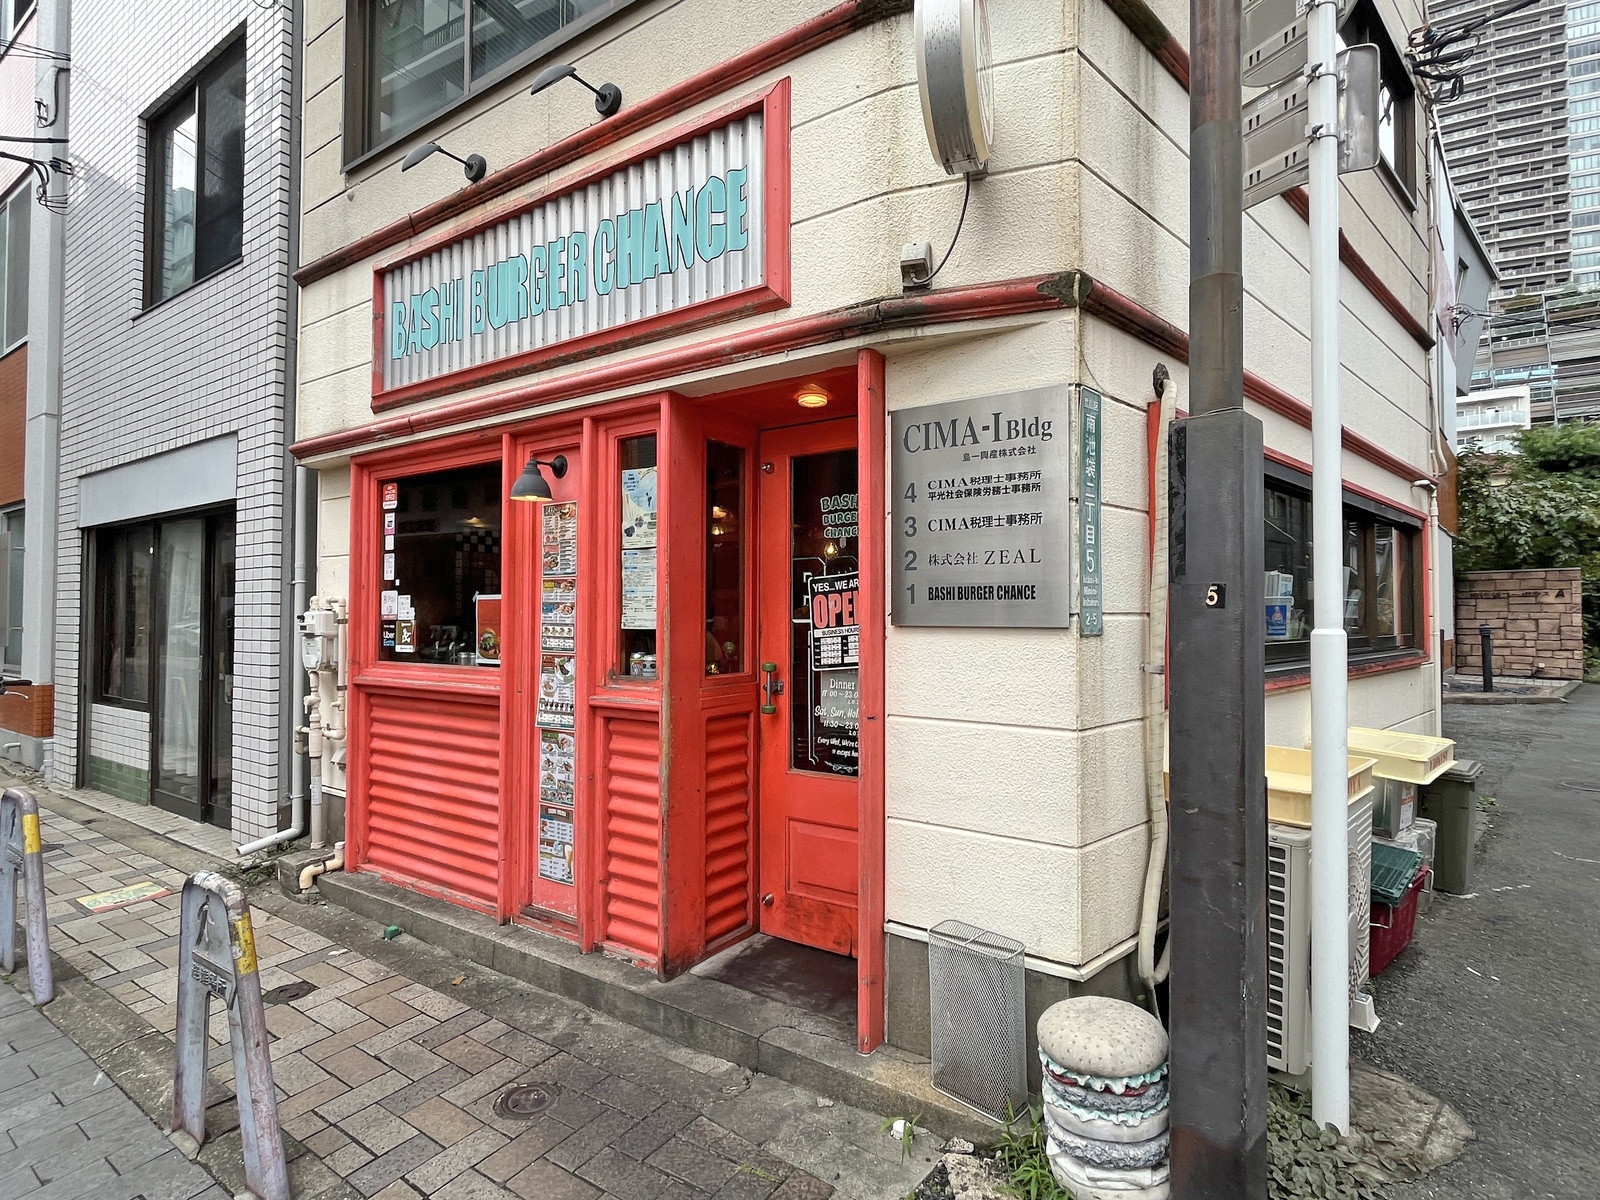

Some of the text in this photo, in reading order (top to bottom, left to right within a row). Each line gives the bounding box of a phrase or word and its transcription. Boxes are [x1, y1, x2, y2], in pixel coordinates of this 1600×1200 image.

[392, 165, 748, 360] BASHI BURGER CHANCE
[1006, 416, 1053, 442] Bldg
[904, 482, 917, 503] 4
[820, 494, 859, 512] BASH
[822, 511, 859, 526] BURGE
[904, 516, 917, 537] 3
[824, 526, 859, 539] CHANC
[904, 548, 1042, 571] 2 株式会社 ZEAL
[849, 578, 859, 588] AR
[906, 584, 1036, 605] 1 BASHI BURGER CHANCE
[1205, 585, 1218, 606] 5
[383, 631, 395, 639] Uber
[821, 628, 844, 637] BUSINESS
[830, 678, 856, 690] Dinner
